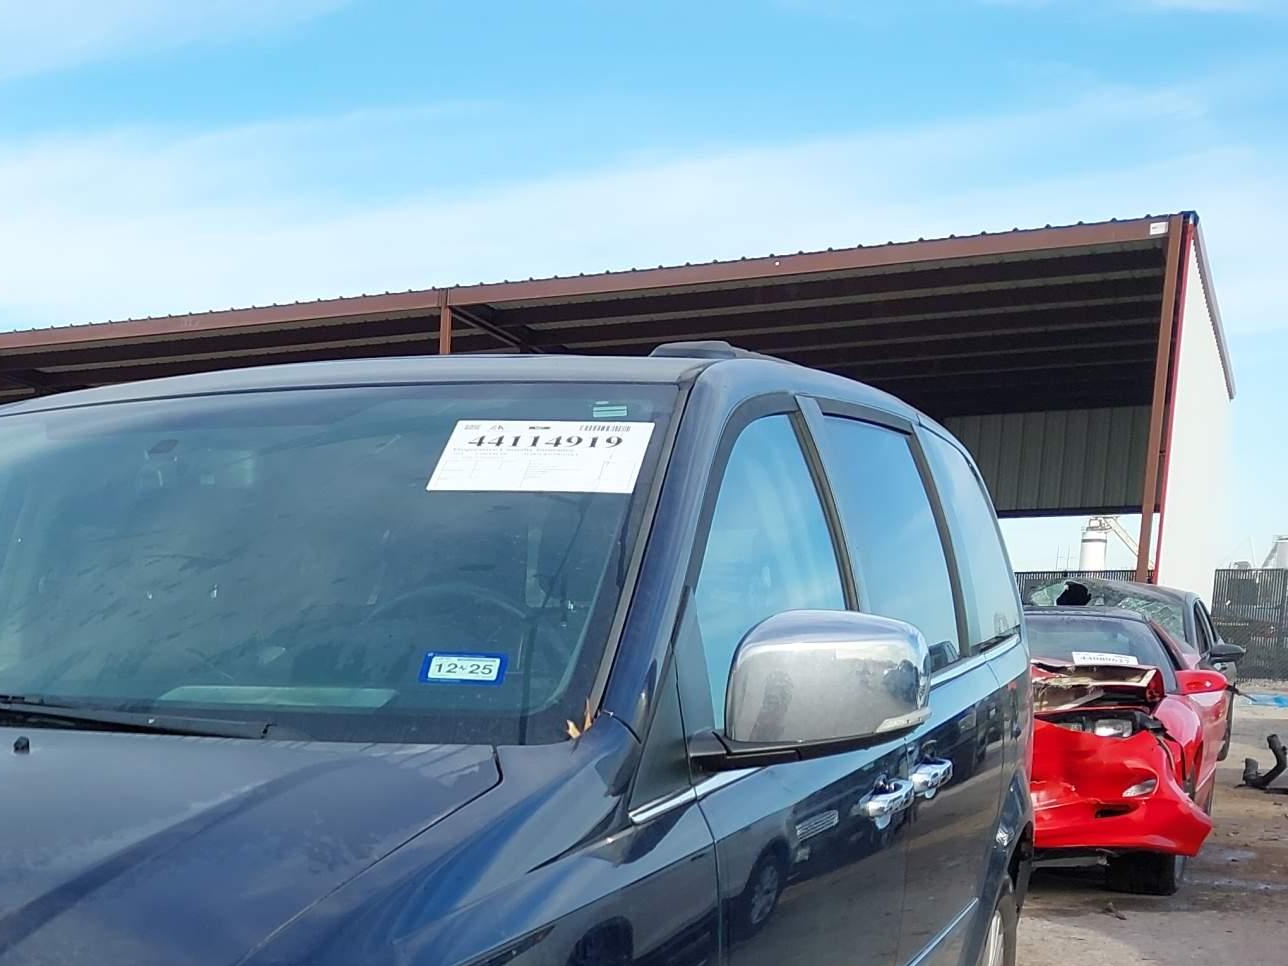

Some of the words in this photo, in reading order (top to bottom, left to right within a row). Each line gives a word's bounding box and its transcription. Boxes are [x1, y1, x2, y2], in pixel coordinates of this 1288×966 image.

[466, 434, 624, 449] 44114919
[433, 662, 458, 674] 12
[468, 663, 494, 676] 25
